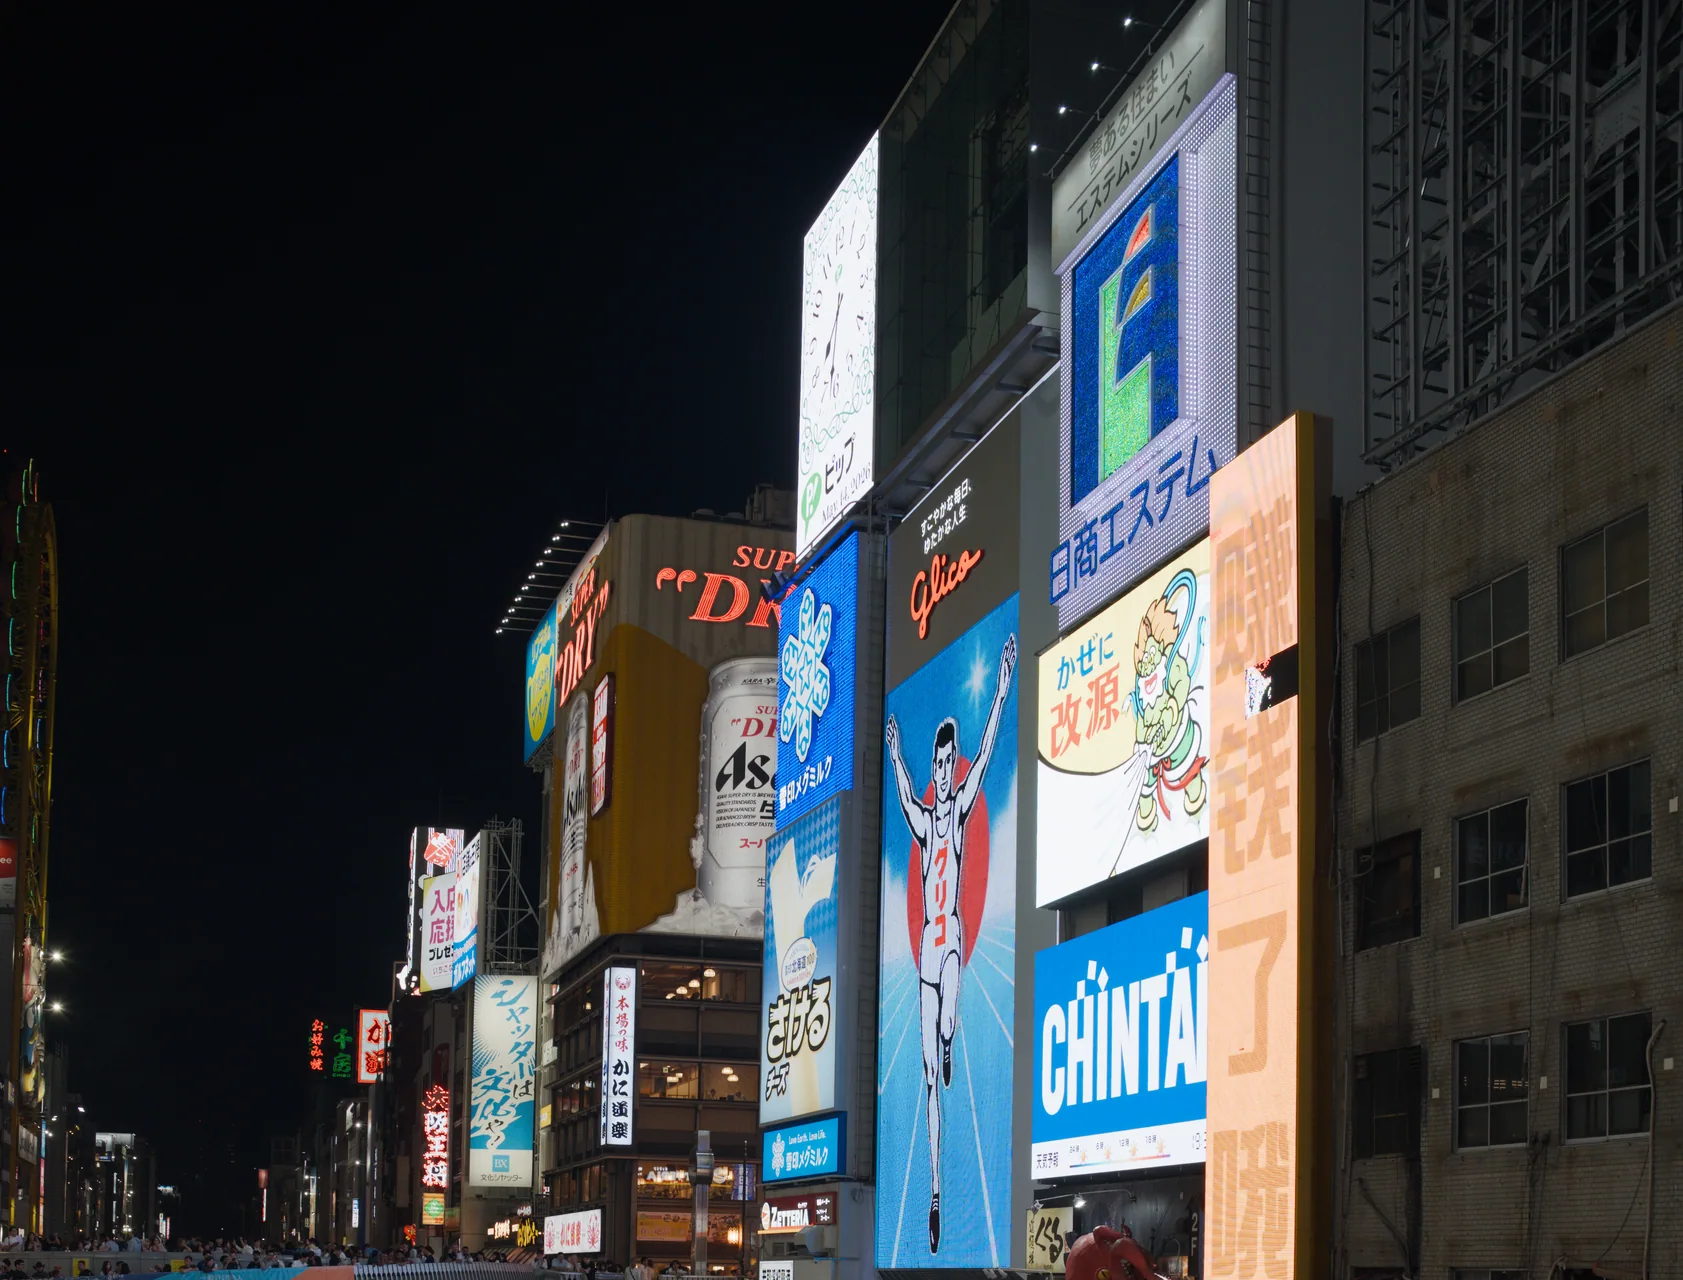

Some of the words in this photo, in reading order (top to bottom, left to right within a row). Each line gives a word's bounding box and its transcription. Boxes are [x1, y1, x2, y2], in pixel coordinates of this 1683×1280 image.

[1089, 51, 1175, 176] 夢ある住まい
[1075, 70, 1192, 234] エステムシリーズ
[824, 432, 857, 495] ピップ
[920, 478, 972, 538] すこやかな毎日、
[923, 504, 967, 555] ゆたかな人生
[1050, 434, 1218, 606] 日商エステム
[570, 567, 595, 628] SUPER
[910, 549, 981, 640] Glico
[1057, 631, 1115, 692] かぜに
[1050, 663, 1121, 759] 改源
[778, 755, 833, 813] 雪印メグミルク
[934, 838, 951, 949] グリコ
[310, 1018, 324, 1071] お好み焼
[614, 994, 630, 1053] 本場の味
[767, 976, 832, 1063] さける
[333, 1028, 353, 1073] 千房
[611, 1059, 630, 1139] かに道楽
[766, 1062, 790, 1102] チーズ
[421, 1085, 450, 1188] 大阪王将
[494, 1157, 507, 1169] BX
[786, 1146, 828, 1171] 雪印メグミルク
[480, 1173, 523, 1182] 文化シャッター
[771, 1206, 809, 1228] ZETTERIA
[1034, 1216, 1064, 1263] くくる
